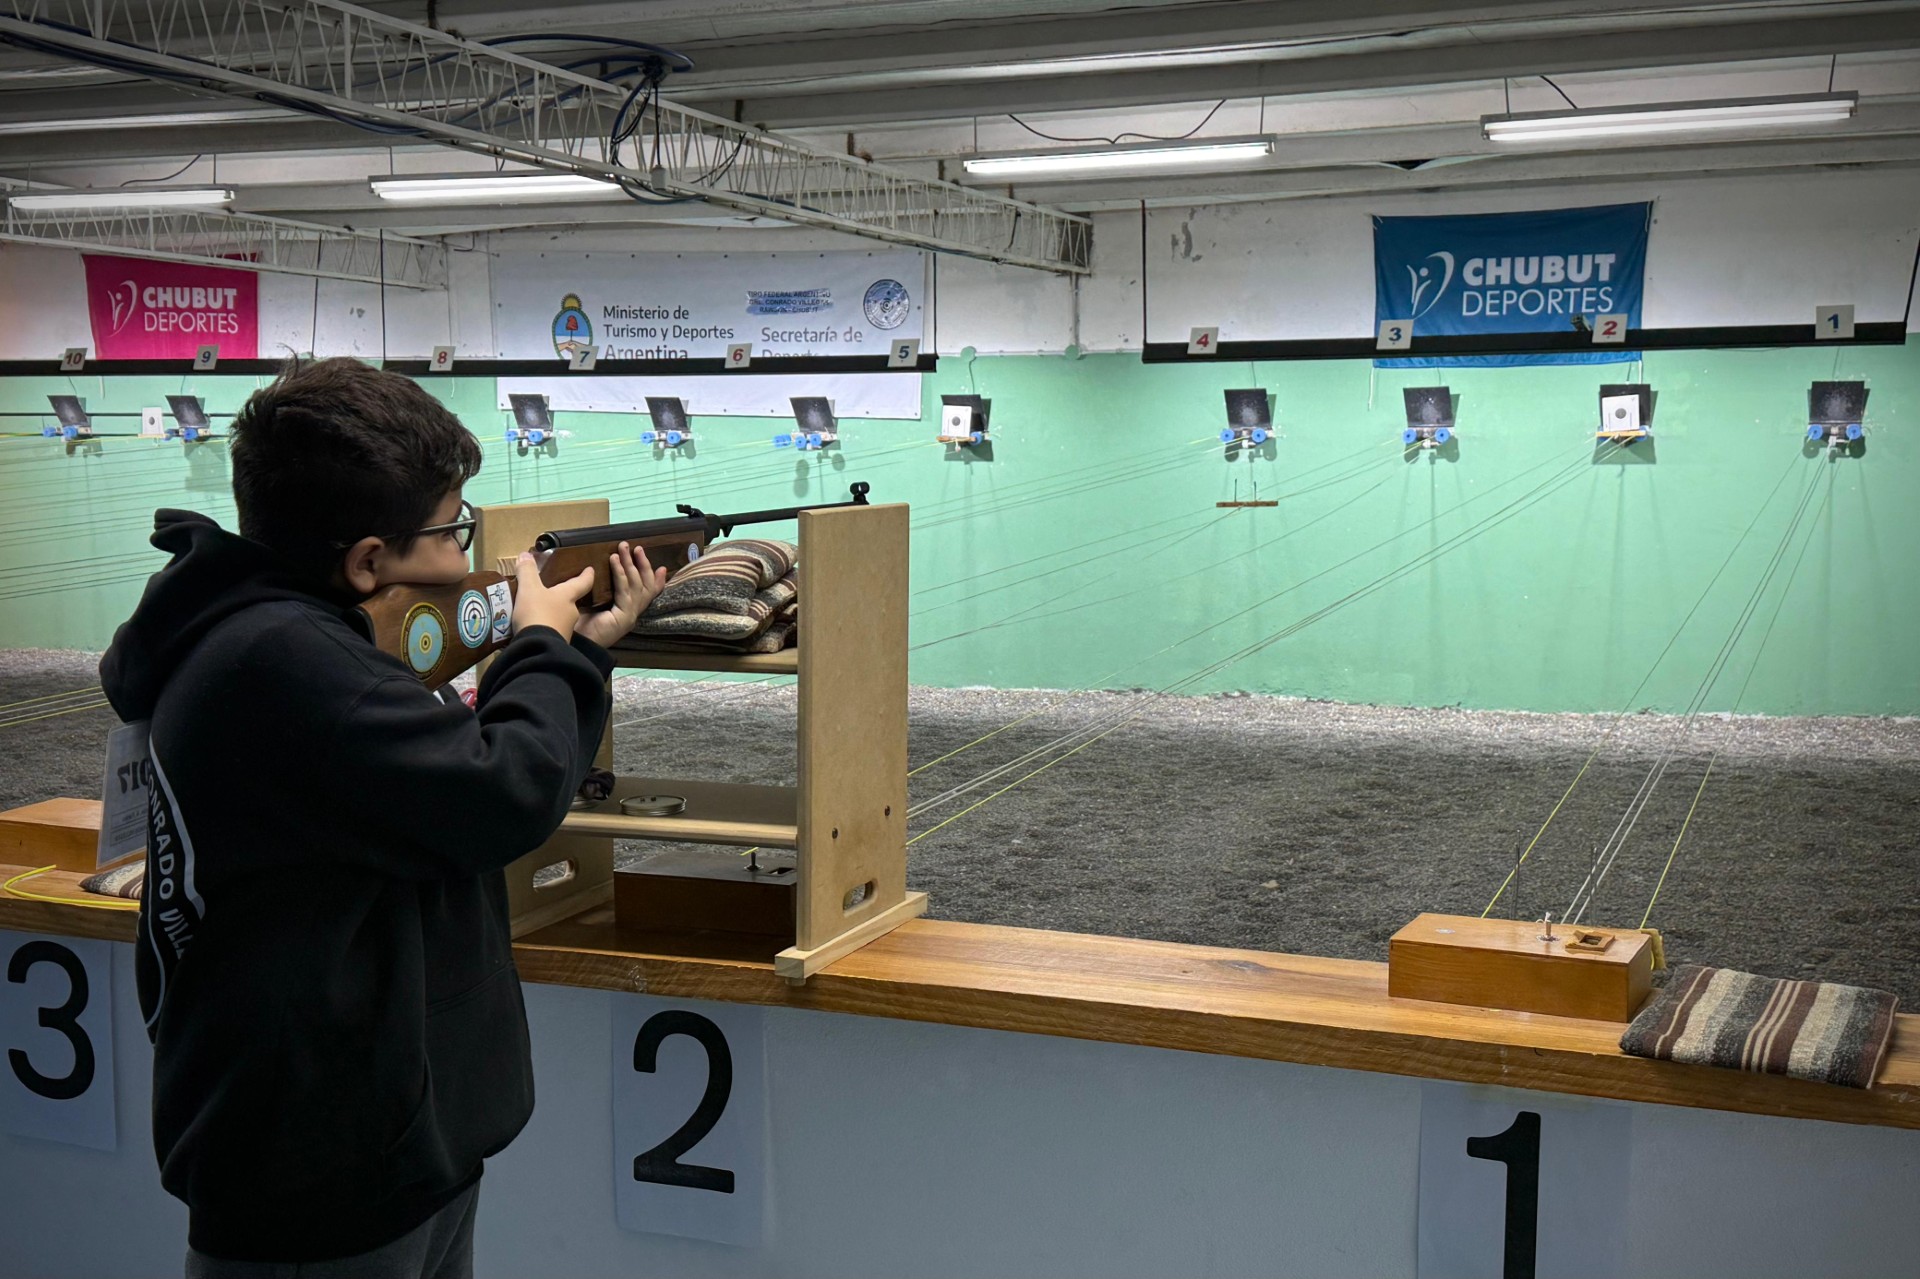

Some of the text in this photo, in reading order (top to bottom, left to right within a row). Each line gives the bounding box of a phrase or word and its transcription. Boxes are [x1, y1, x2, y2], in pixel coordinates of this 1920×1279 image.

[1462, 253, 1616, 287] CHUBUT
[143, 286, 238, 309] CHUBUT
[1461, 286, 1614, 316] DEPORTES
[603, 305, 690, 320] Ministerio de
[144, 311, 239, 334] DEPORTES
[1602, 321, 1618, 336] 2
[1827, 313, 1839, 329] 1
[603, 324, 734, 341] Turismo y Deportes
[761, 326, 863, 343] Secretaría de
[1196, 333, 1210, 348] 4
[1388, 327, 1402, 342] 3
[66, 352, 83, 365] 10
[201, 351, 211, 363] 9
[437, 351, 448, 364] 8
[579, 351, 590, 364] 7
[604, 344, 689, 360] Argentina
[732, 348, 744, 362] 6
[898, 345, 910, 359] 5
[148, 763, 175, 900] ONRADO
[7, 940, 96, 1100] 3
[633, 1009, 735, 1195] 2
[1466, 1110, 1542, 1279] 1
